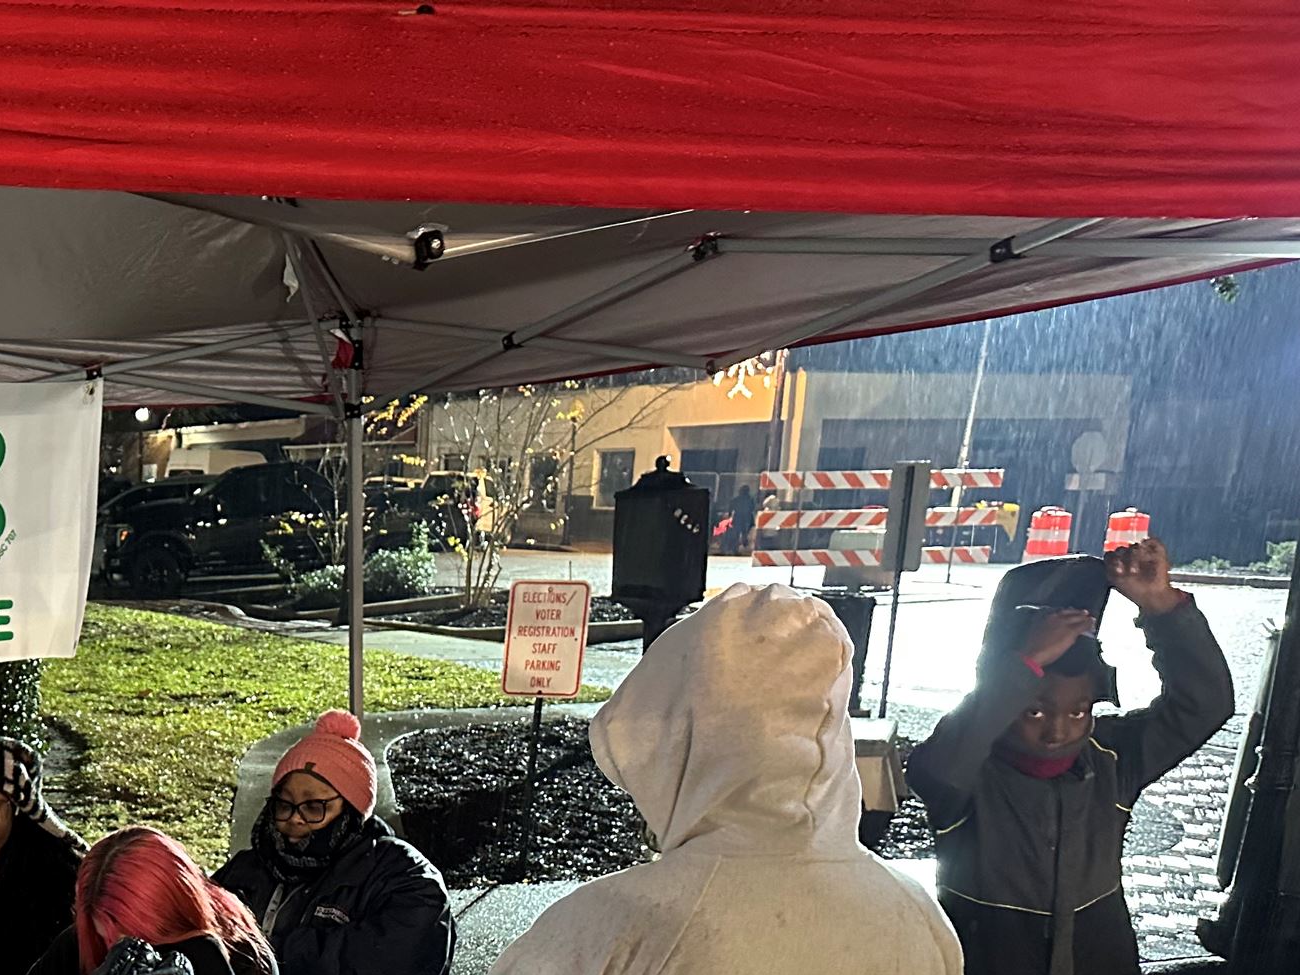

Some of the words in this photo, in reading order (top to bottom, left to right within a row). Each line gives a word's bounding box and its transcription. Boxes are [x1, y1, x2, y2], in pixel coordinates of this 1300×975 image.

[4, 529, 17, 545] 707
[522, 591, 577, 606] ELECTIONS/
[535, 609, 562, 620] VOTER
[517, 626, 575, 638] REGISTRATION
[531, 643, 558, 654] STAFF
[524, 660, 561, 671] PARKING
[529, 677, 552, 688] ONLY
